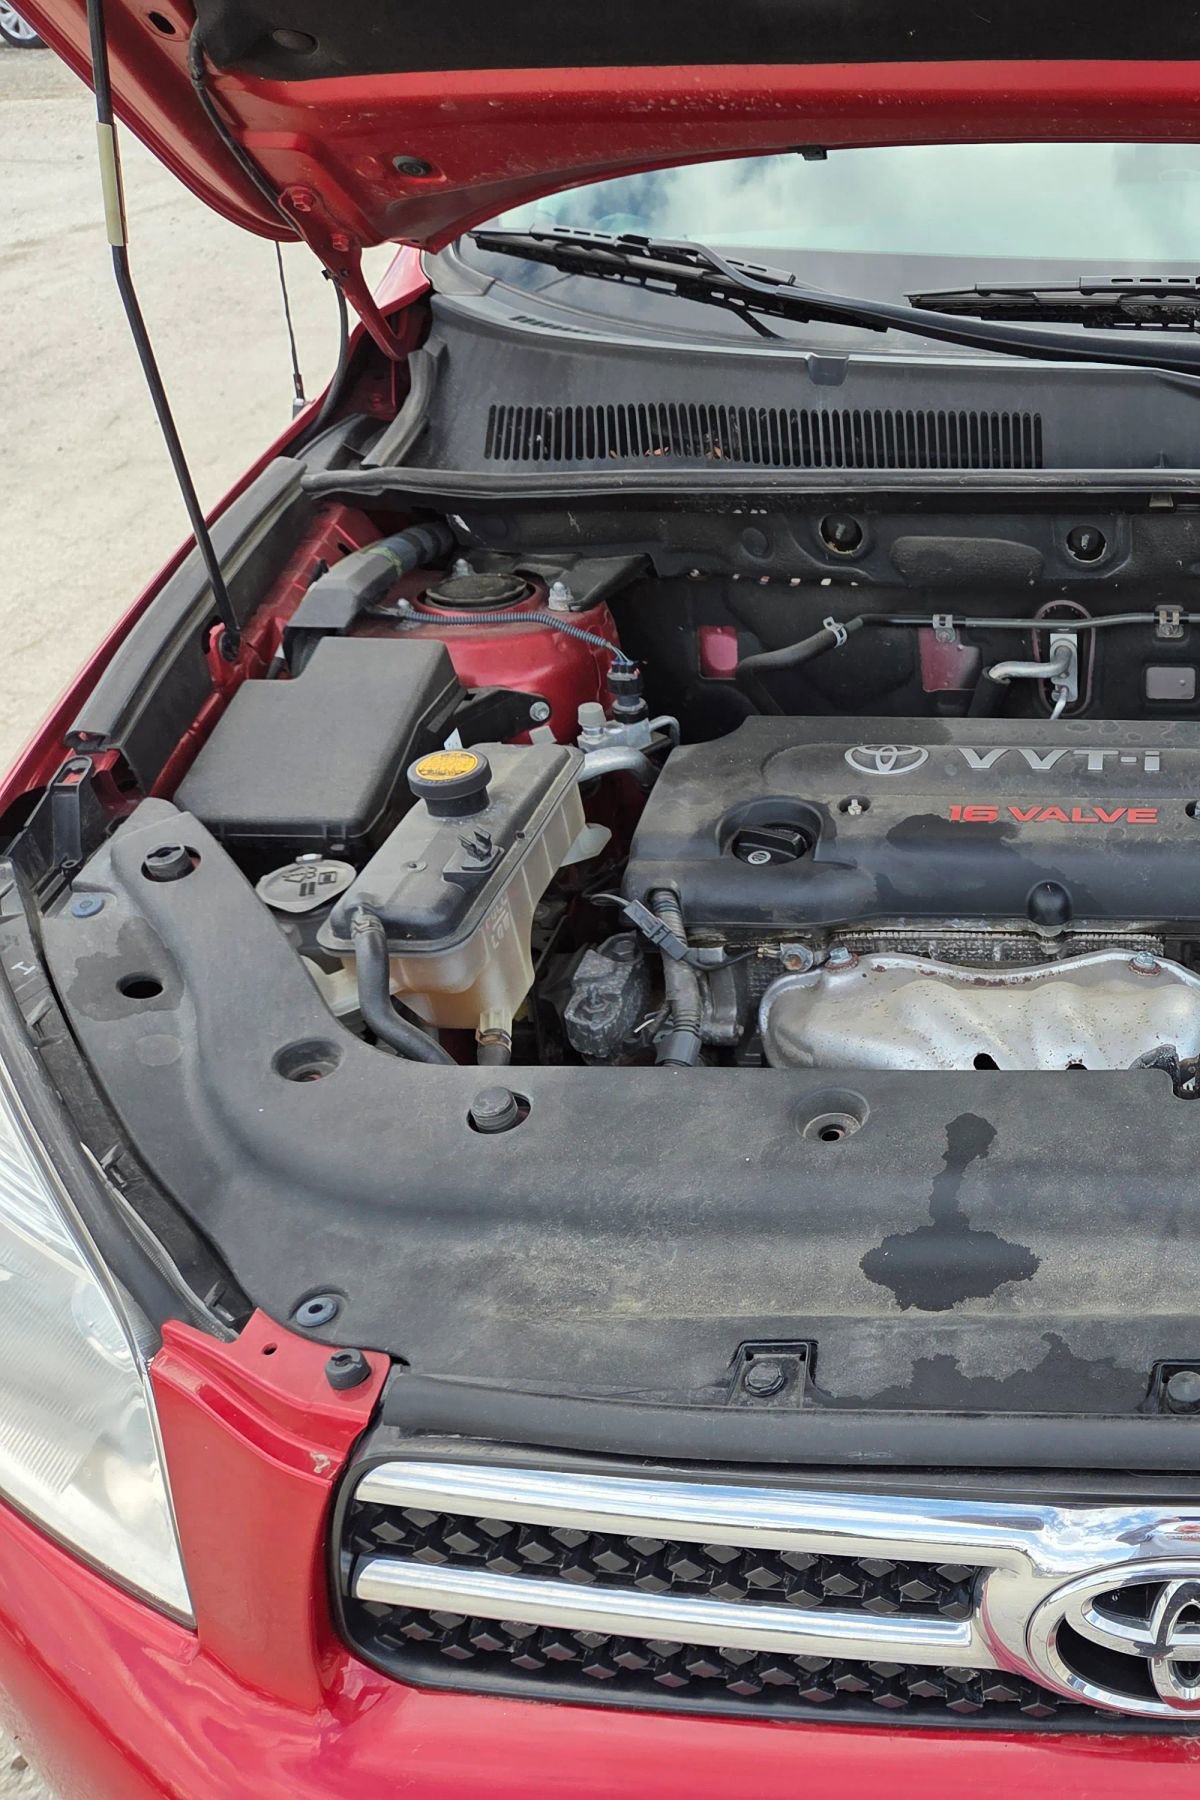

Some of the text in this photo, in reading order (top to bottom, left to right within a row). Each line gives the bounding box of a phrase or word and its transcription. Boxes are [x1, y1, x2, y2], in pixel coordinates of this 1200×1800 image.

[957, 747, 1161, 772] VVT-i
[949, 804, 1160, 824] 16 VALVE
